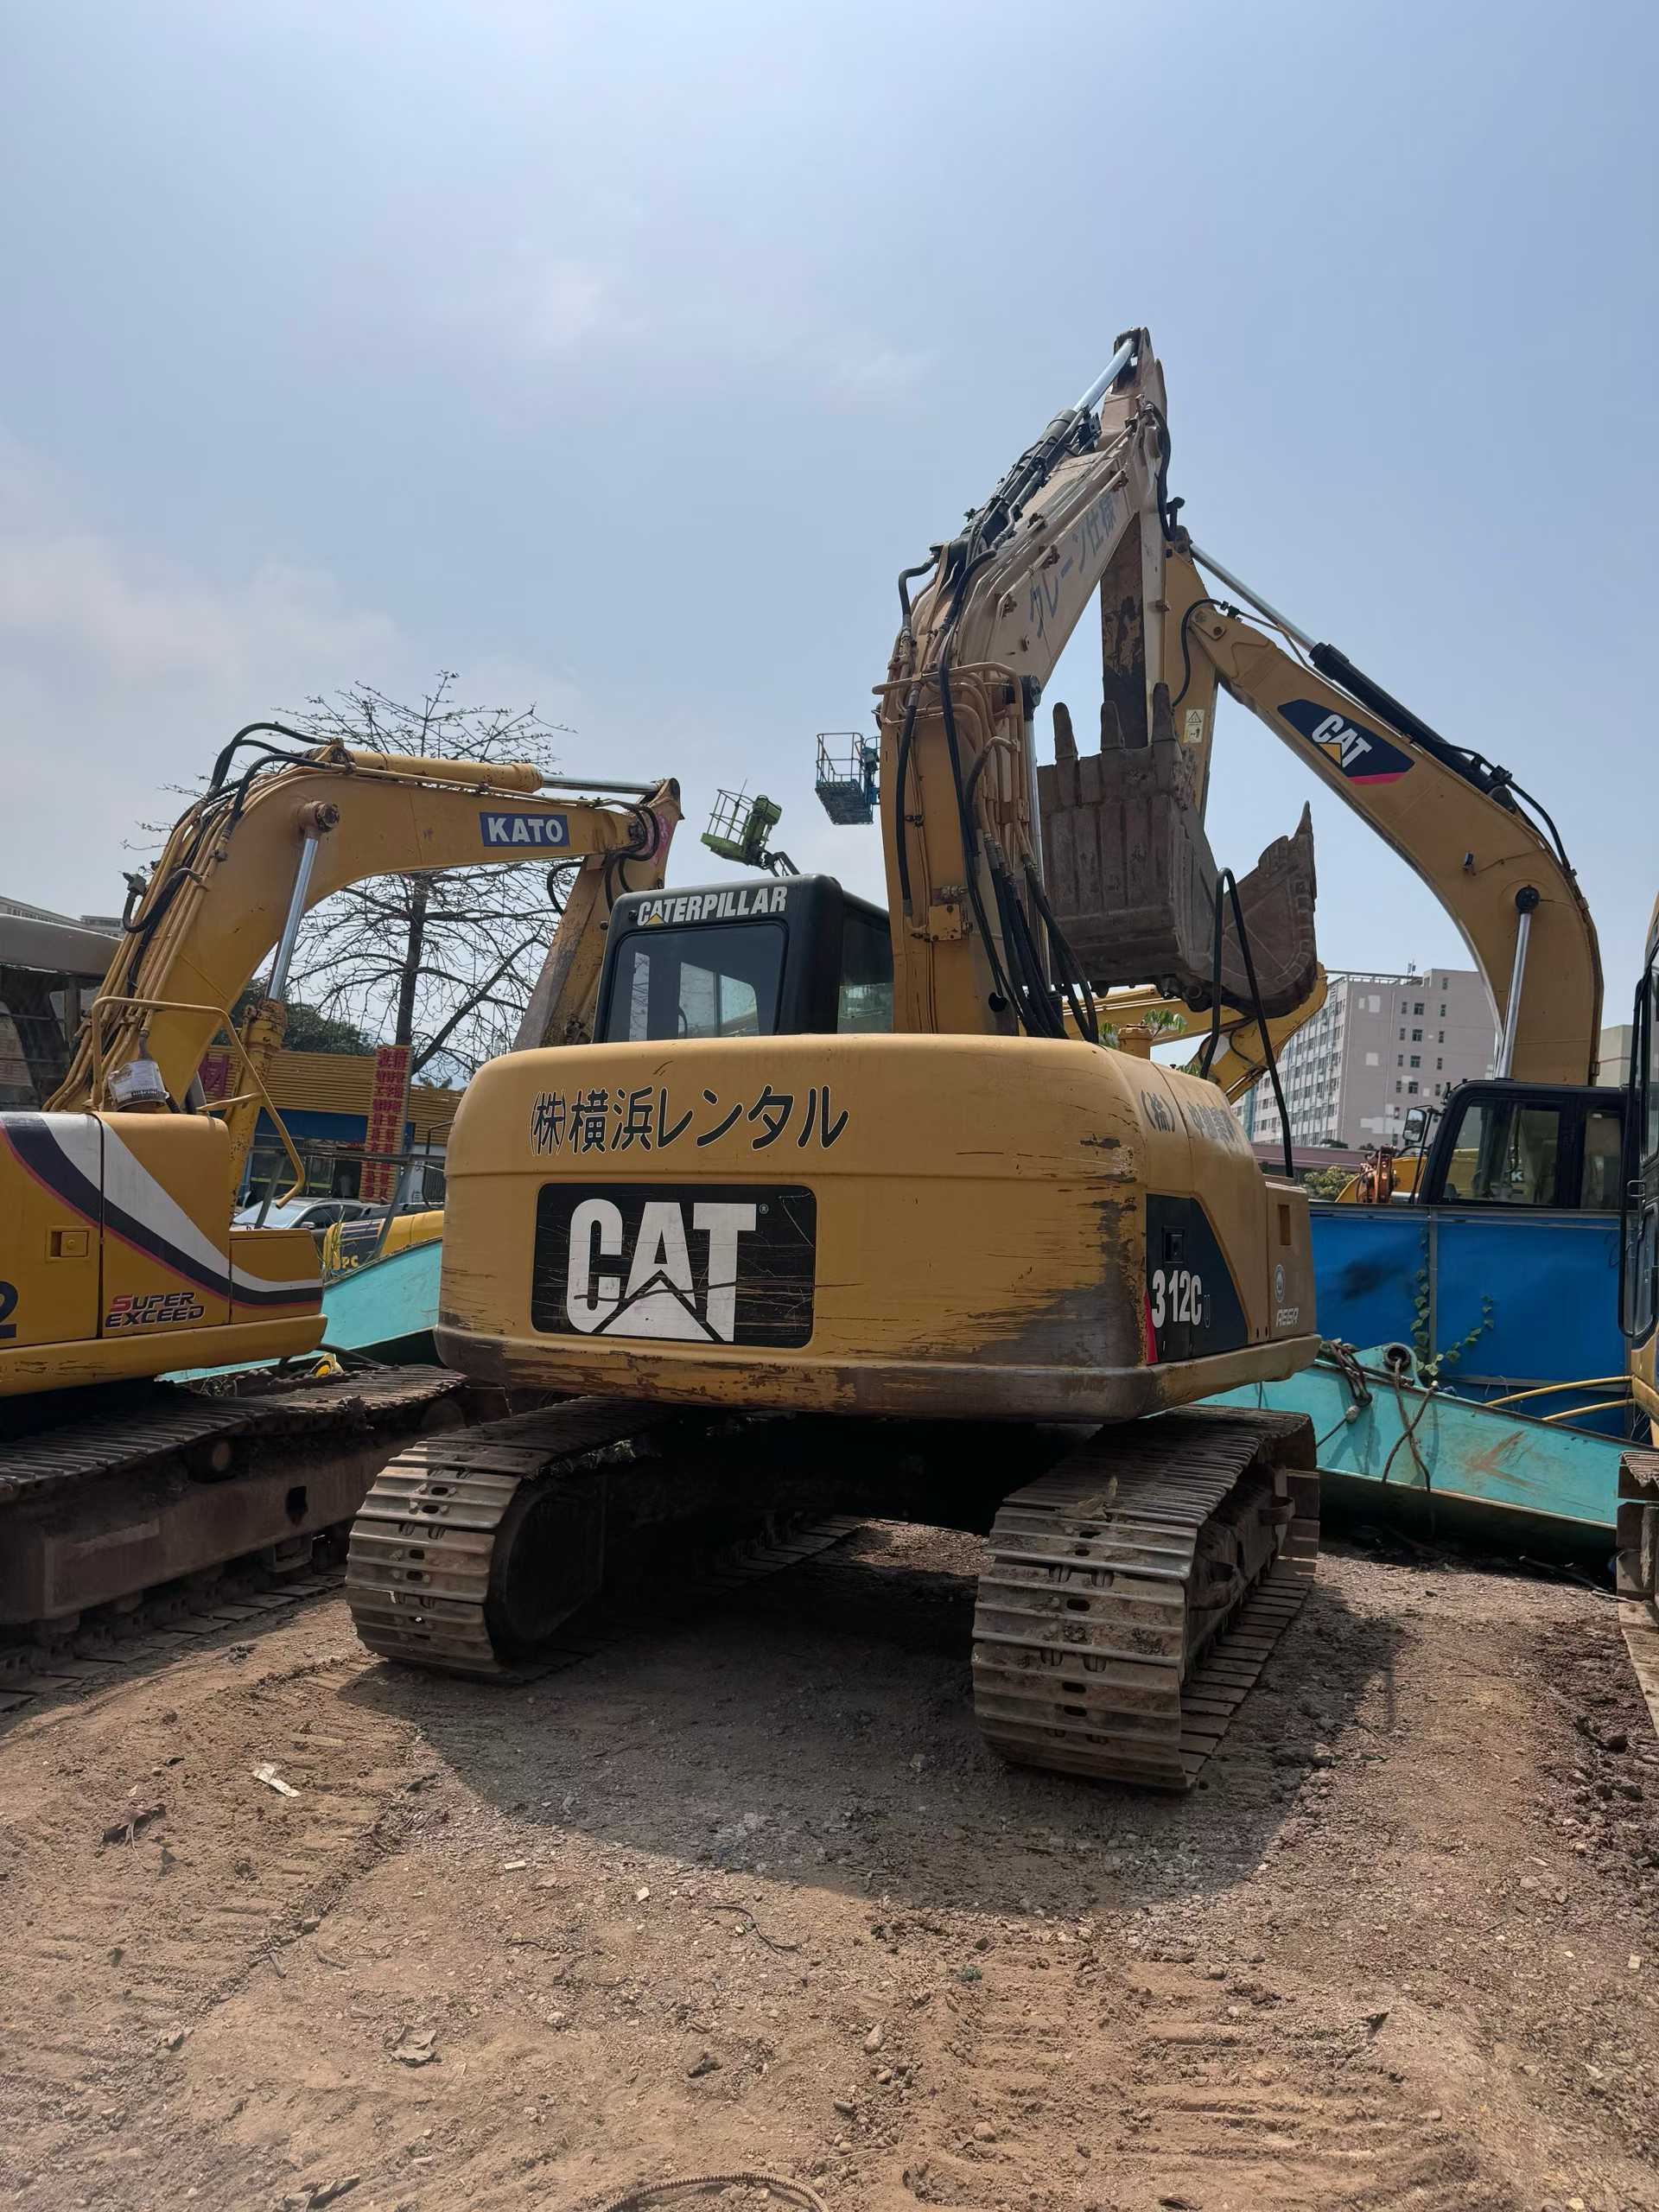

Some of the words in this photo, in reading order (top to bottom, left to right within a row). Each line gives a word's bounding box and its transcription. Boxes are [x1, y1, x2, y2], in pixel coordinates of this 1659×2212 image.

[1312, 714, 1373, 768] CAT
[487, 817, 563, 843] KATO
[637, 887, 788, 926] CATERPILLAR
[566, 1198, 757, 1342] CAT
[105, 1306, 206, 1328] EXCEED
[109, 1292, 196, 1314] SUPER
